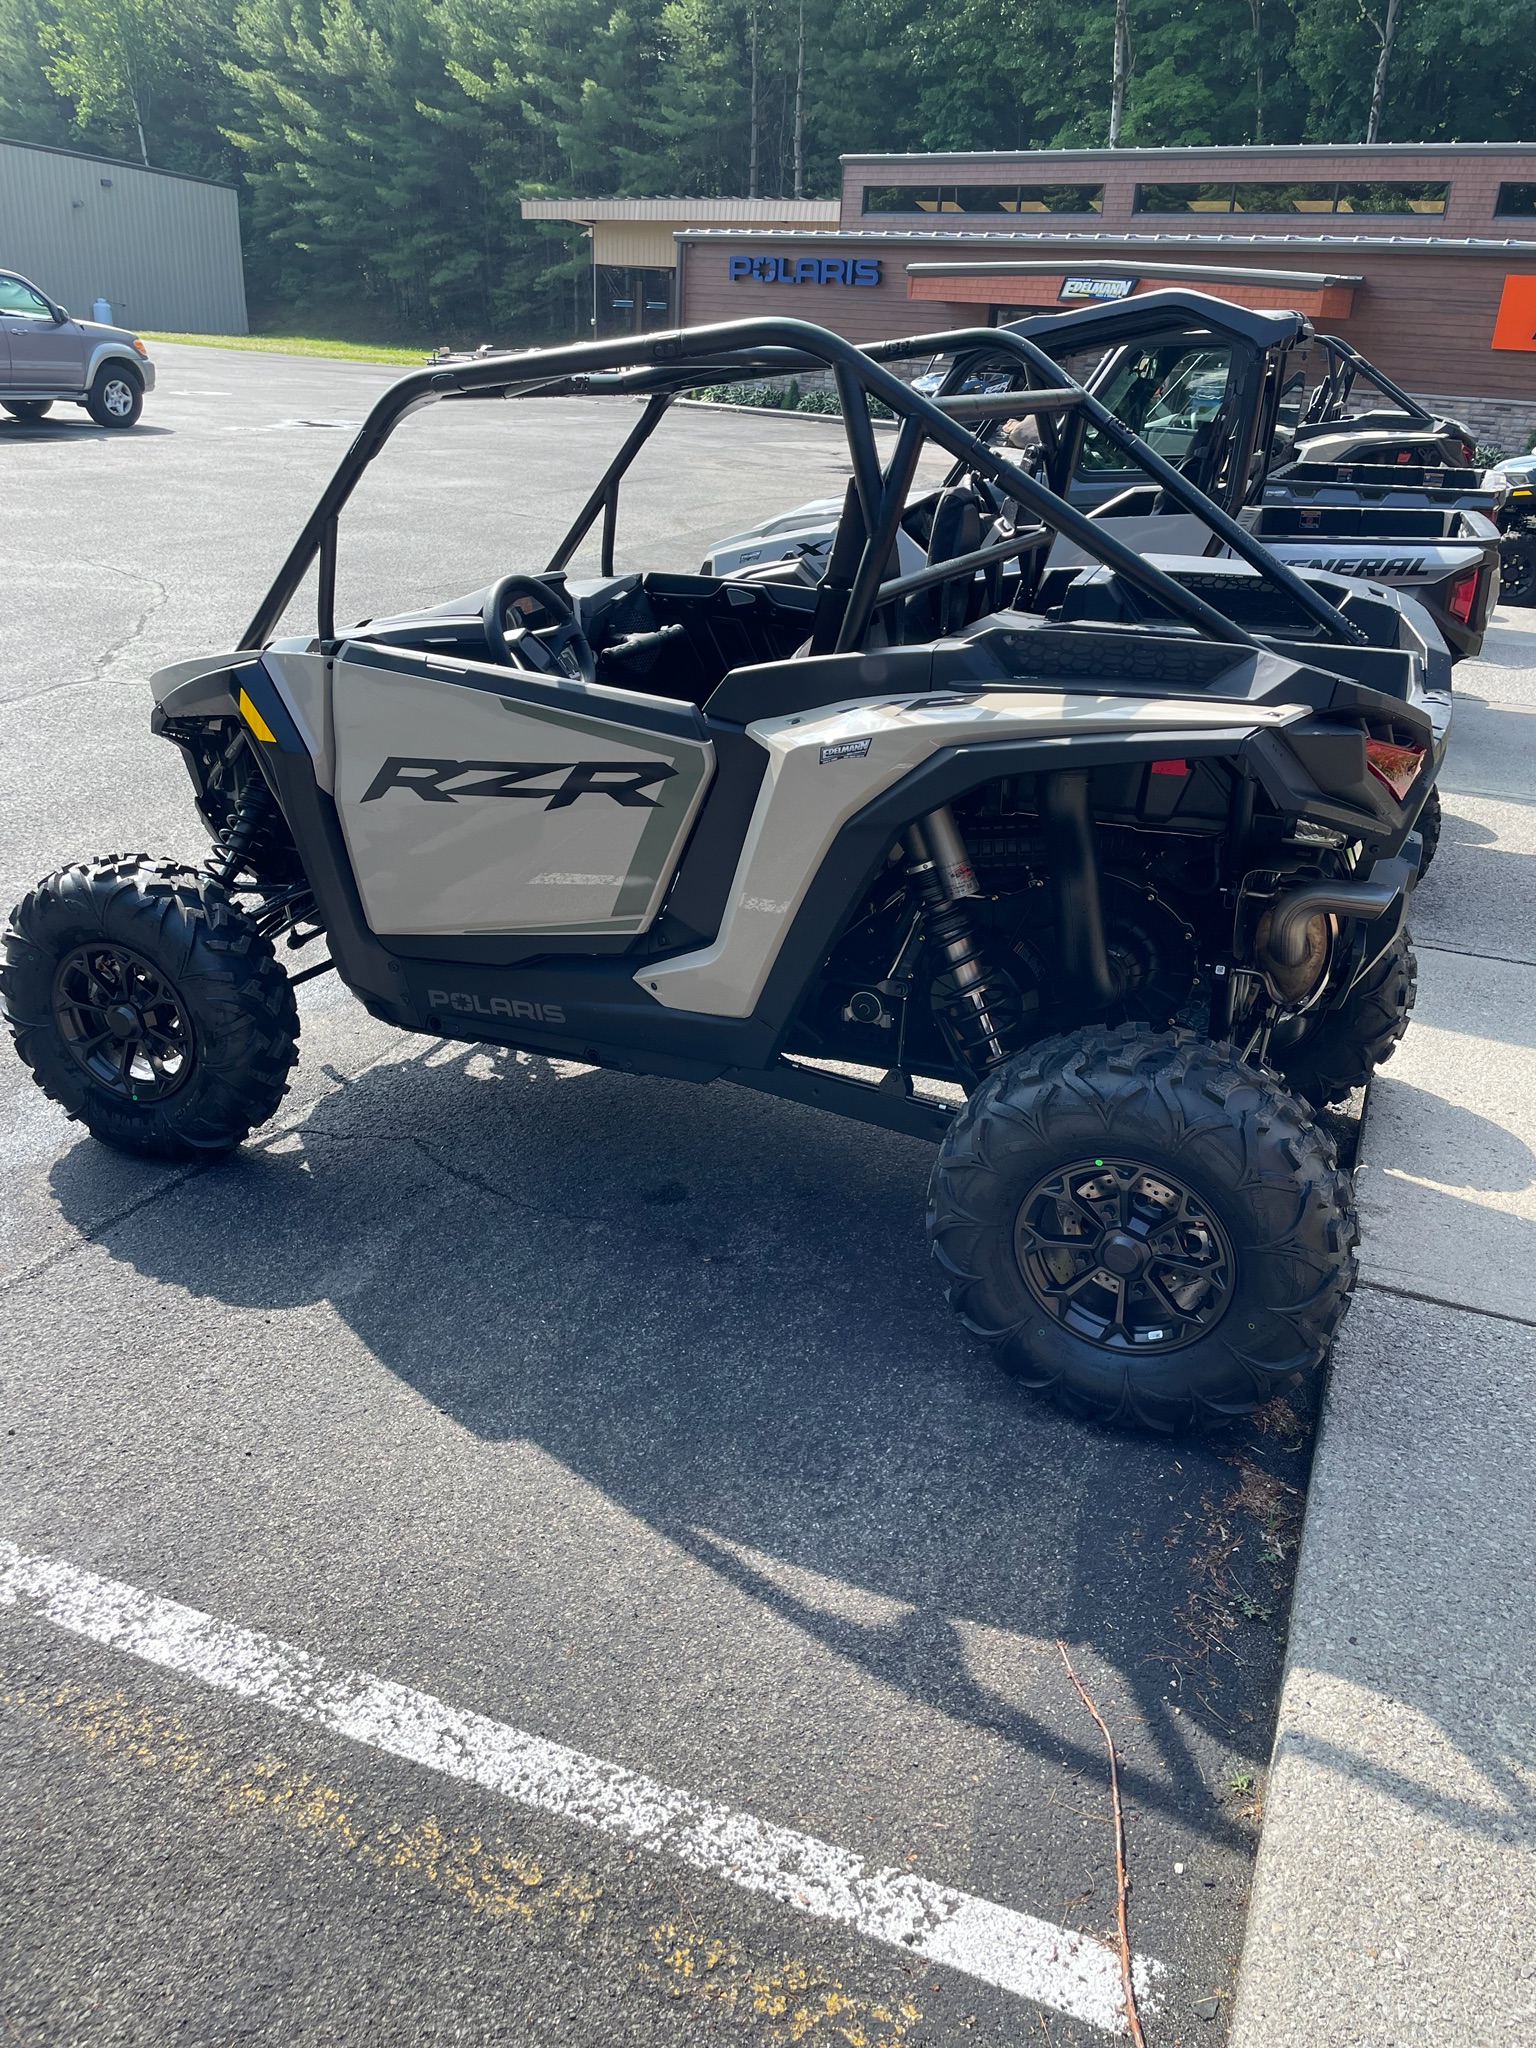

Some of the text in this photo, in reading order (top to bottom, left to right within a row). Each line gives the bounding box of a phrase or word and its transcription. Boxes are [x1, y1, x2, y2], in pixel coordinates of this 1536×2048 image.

[729, 255, 880, 286] POLARIS
[1060, 280, 1133, 298] EDELMANN
[359, 756, 680, 812] RZR
[427, 989, 567, 1025] POLARIS
